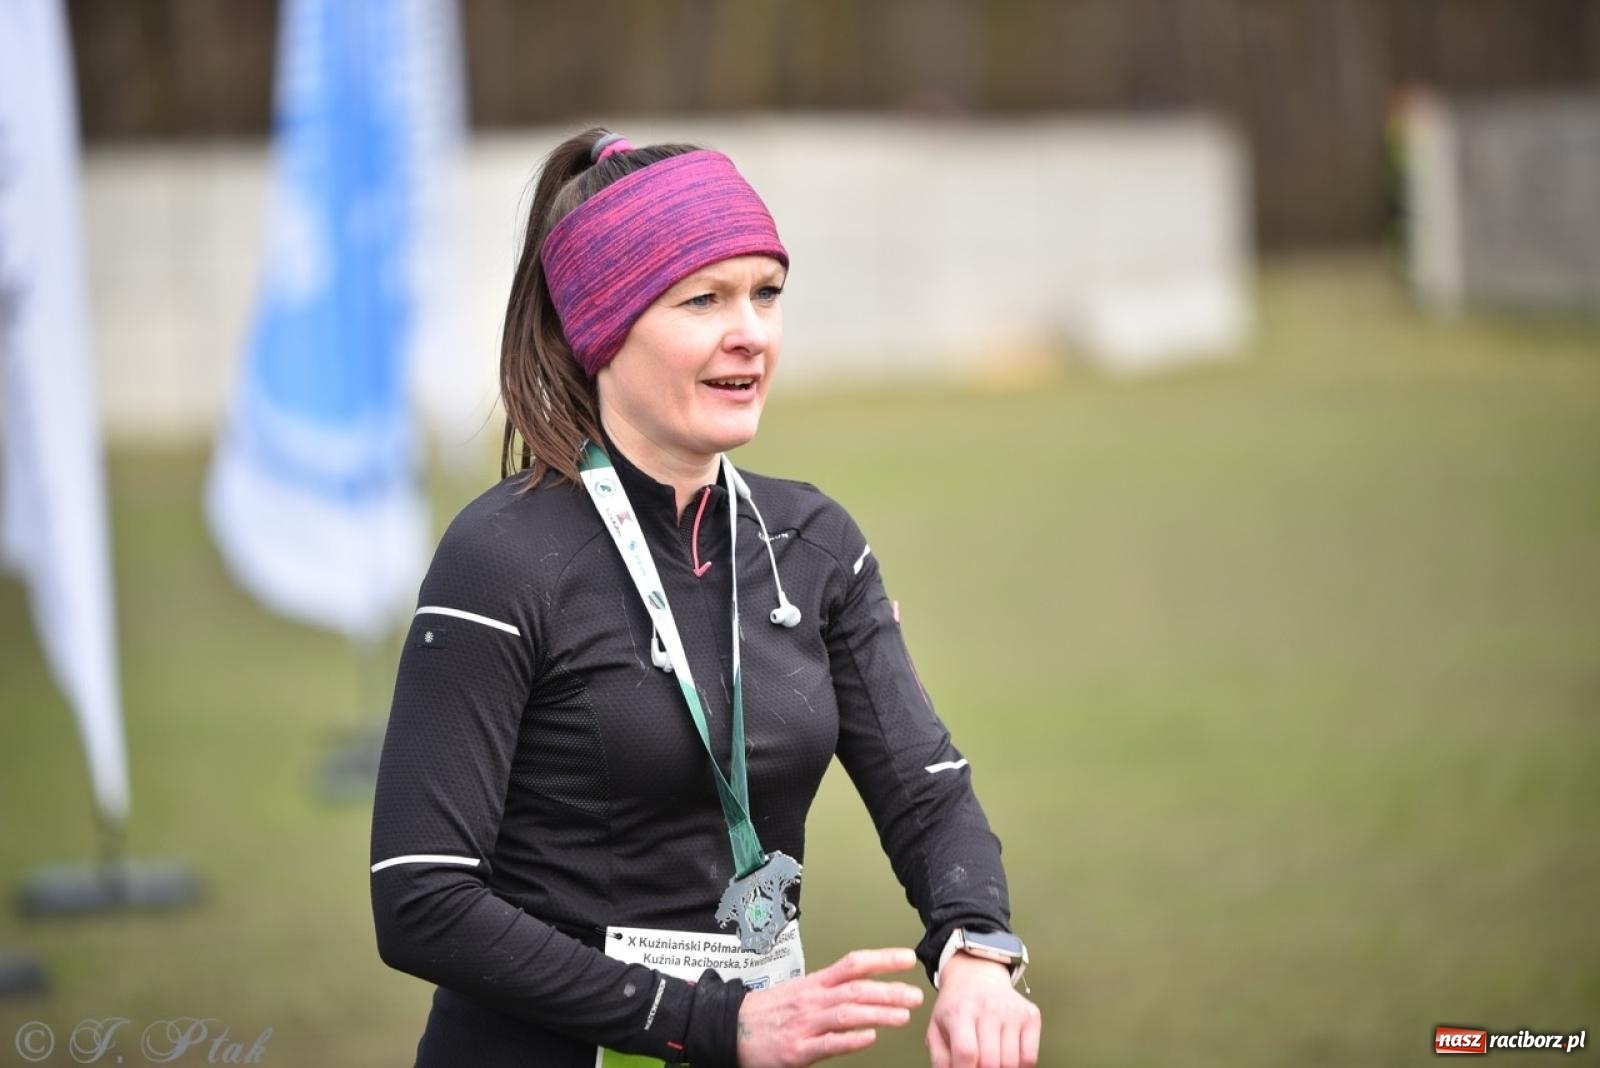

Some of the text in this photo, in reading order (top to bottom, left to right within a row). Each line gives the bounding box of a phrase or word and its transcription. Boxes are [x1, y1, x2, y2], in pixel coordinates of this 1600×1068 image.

[628, 936, 637, 947] X
[639, 937, 701, 952] Kuźniański
[643, 953, 681, 966] Kuźnia
[683, 955, 742, 970] Raciborska,
[743, 958, 750, 969] 5
